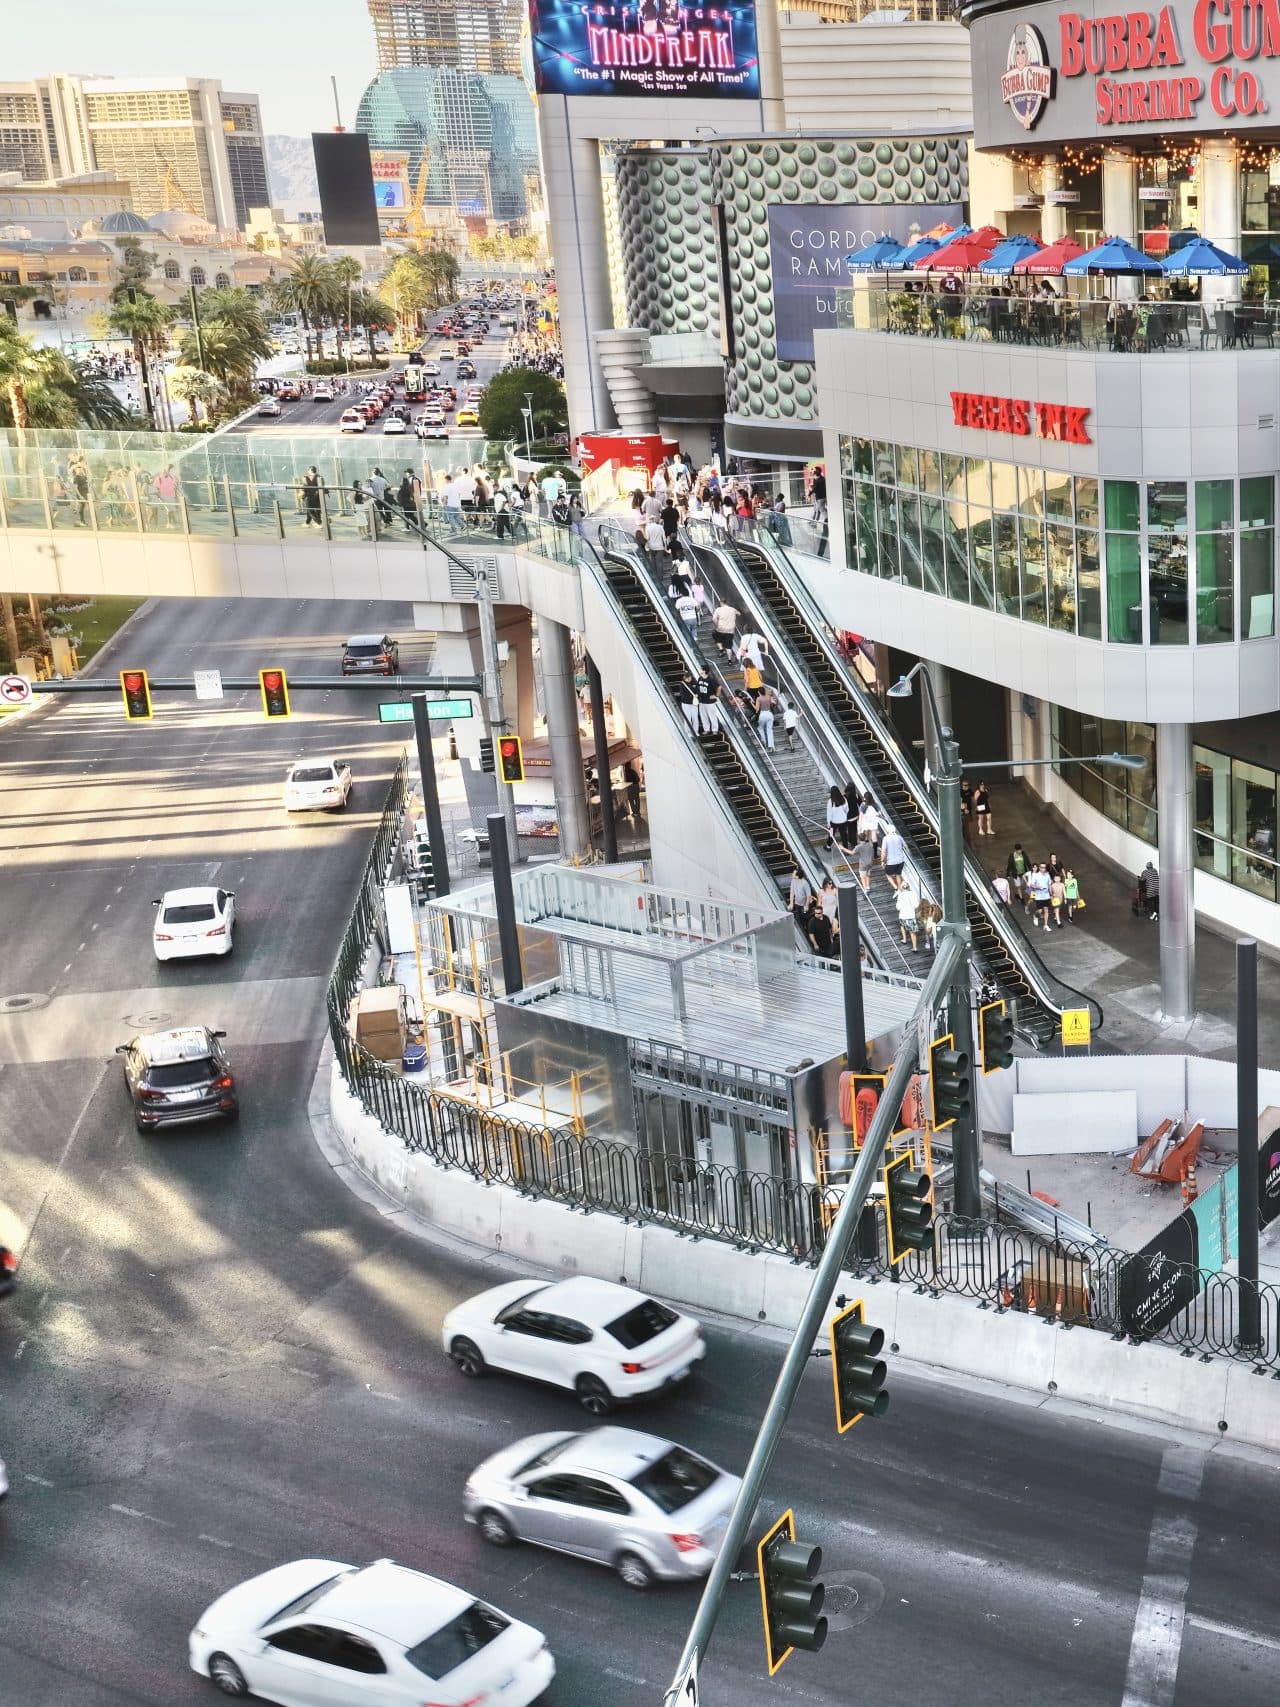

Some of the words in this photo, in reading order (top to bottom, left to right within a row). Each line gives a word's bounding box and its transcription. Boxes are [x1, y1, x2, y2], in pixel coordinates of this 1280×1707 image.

[679, 8, 733, 20] NGEL
[1059, 5, 1182, 77] BUBBA
[601, 70, 616, 80] #1
[620, 70, 653, 83] Magic
[655, 70, 685, 82] Show
[686, 71, 699, 82] of
[700, 71, 715, 83] All
[1095, 77, 1200, 125] SHRIMP
[816, 295, 855, 317] burg
[950, 391, 1031, 436] VEGAS
[1033, 402, 1093, 445] INK
[395, 704, 451, 719] Haon
